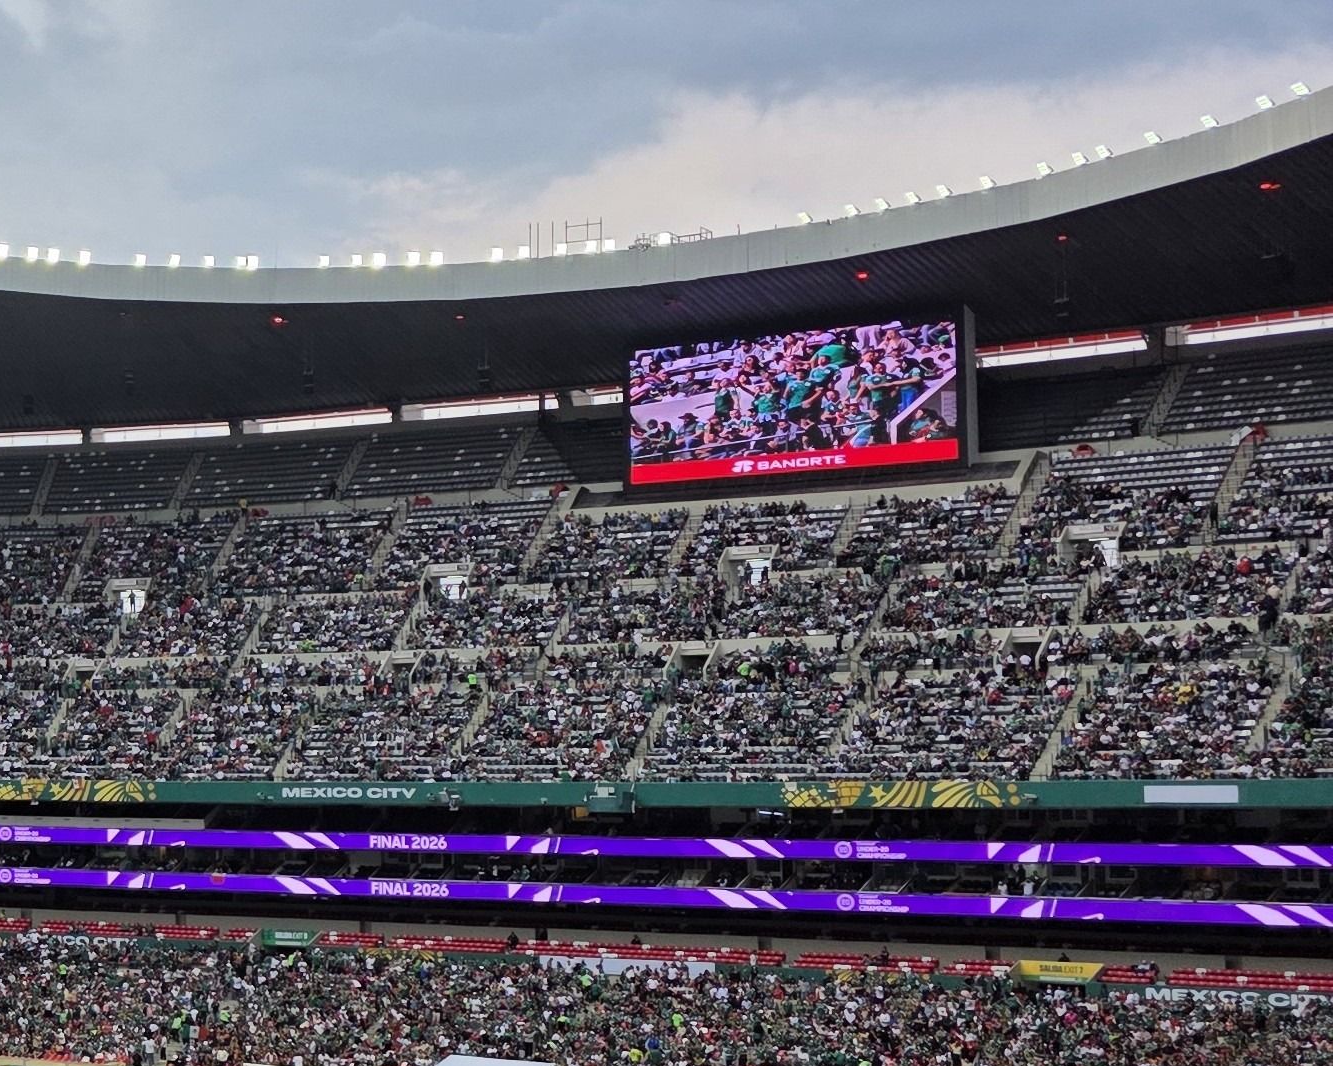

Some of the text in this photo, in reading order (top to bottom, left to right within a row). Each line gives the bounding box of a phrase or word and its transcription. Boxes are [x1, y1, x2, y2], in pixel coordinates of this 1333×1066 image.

[757, 455, 846, 471] BANORTE
[281, 787, 417, 799] MEXICO CITY
[369, 835, 448, 850] FINAL 2026
[370, 881, 450, 897] FINAL 2026
